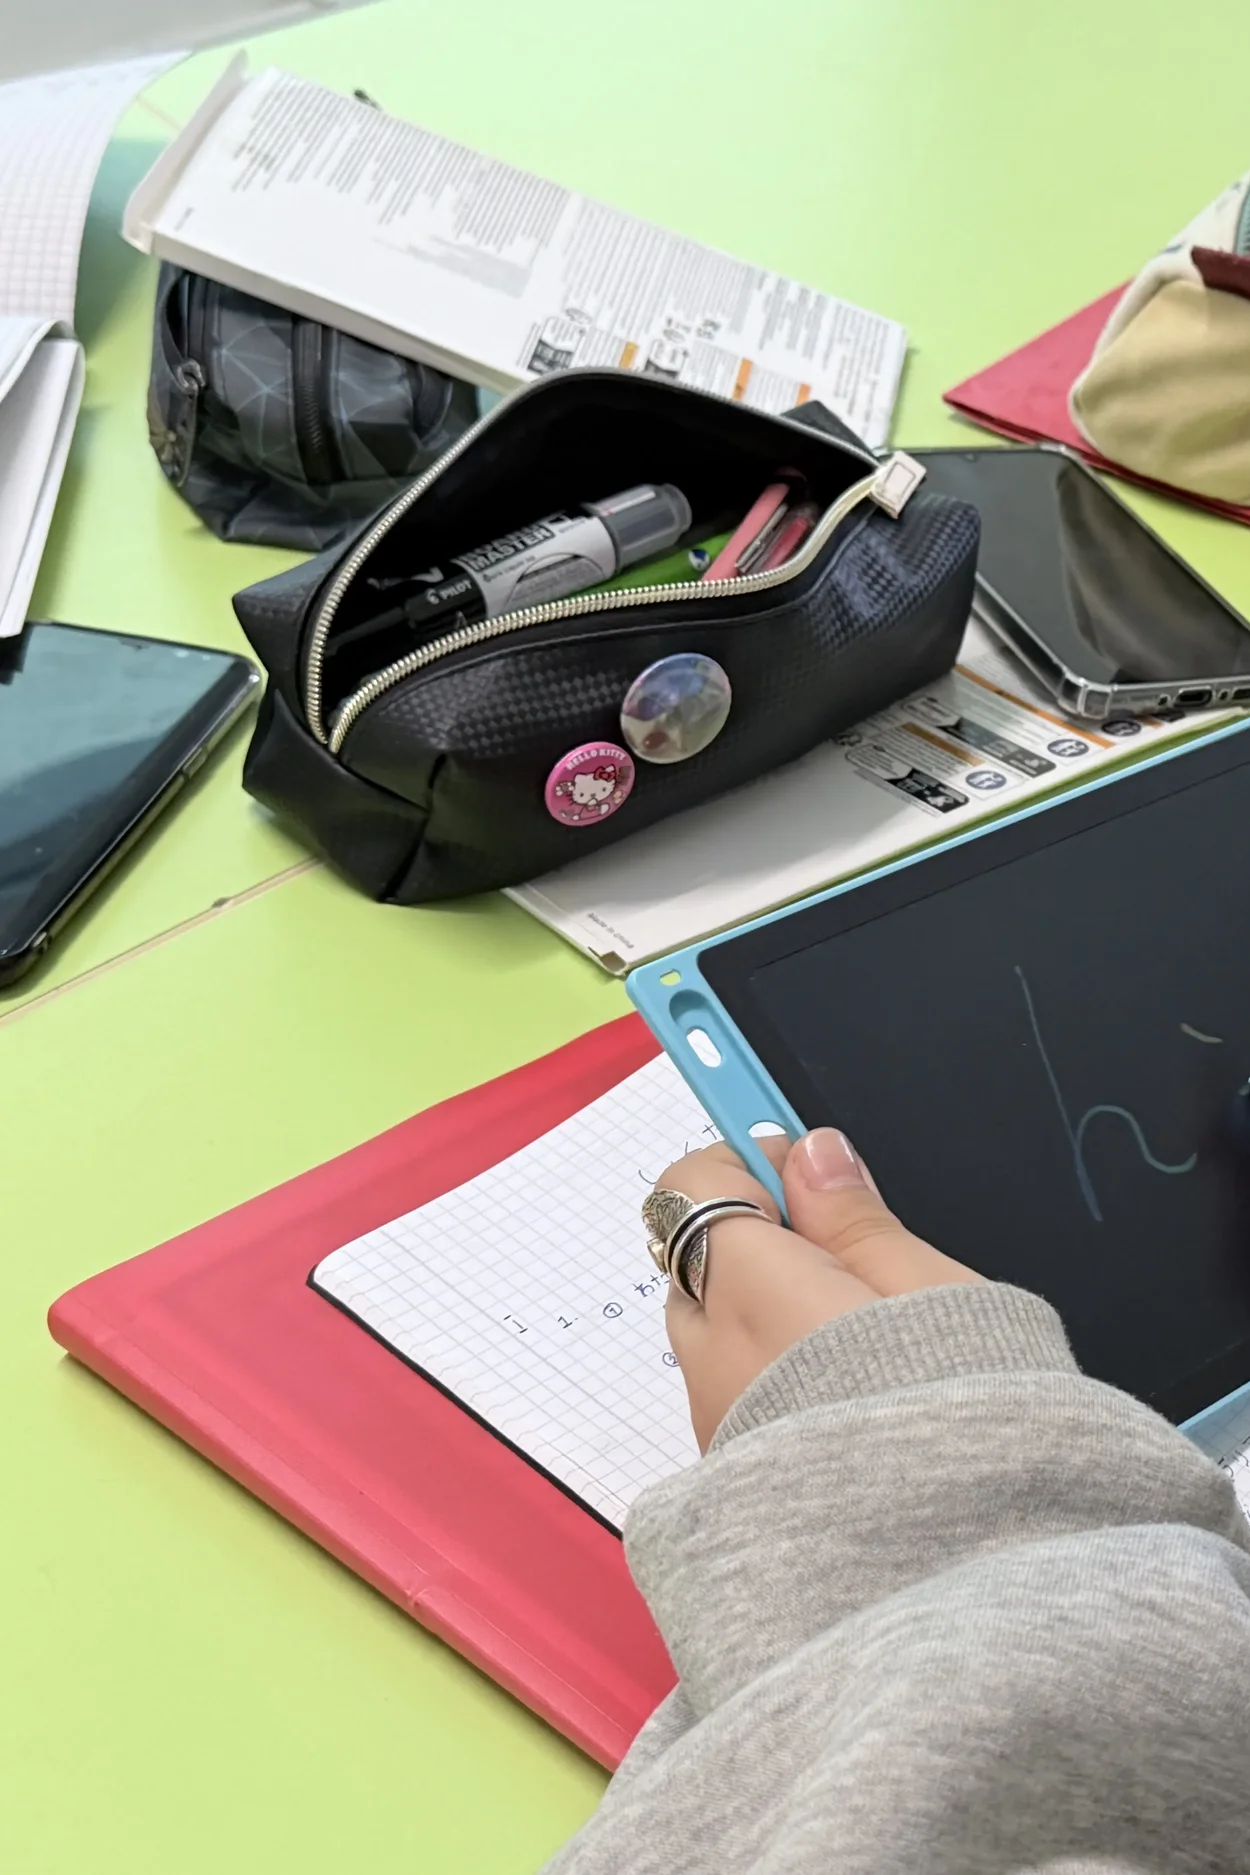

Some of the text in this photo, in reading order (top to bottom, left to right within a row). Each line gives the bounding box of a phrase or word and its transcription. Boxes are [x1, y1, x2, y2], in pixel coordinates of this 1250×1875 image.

[470, 527, 554, 571] MASTER
[439, 579, 473, 601] PILOT
[566, 748, 628, 770] HELLO KITTY
